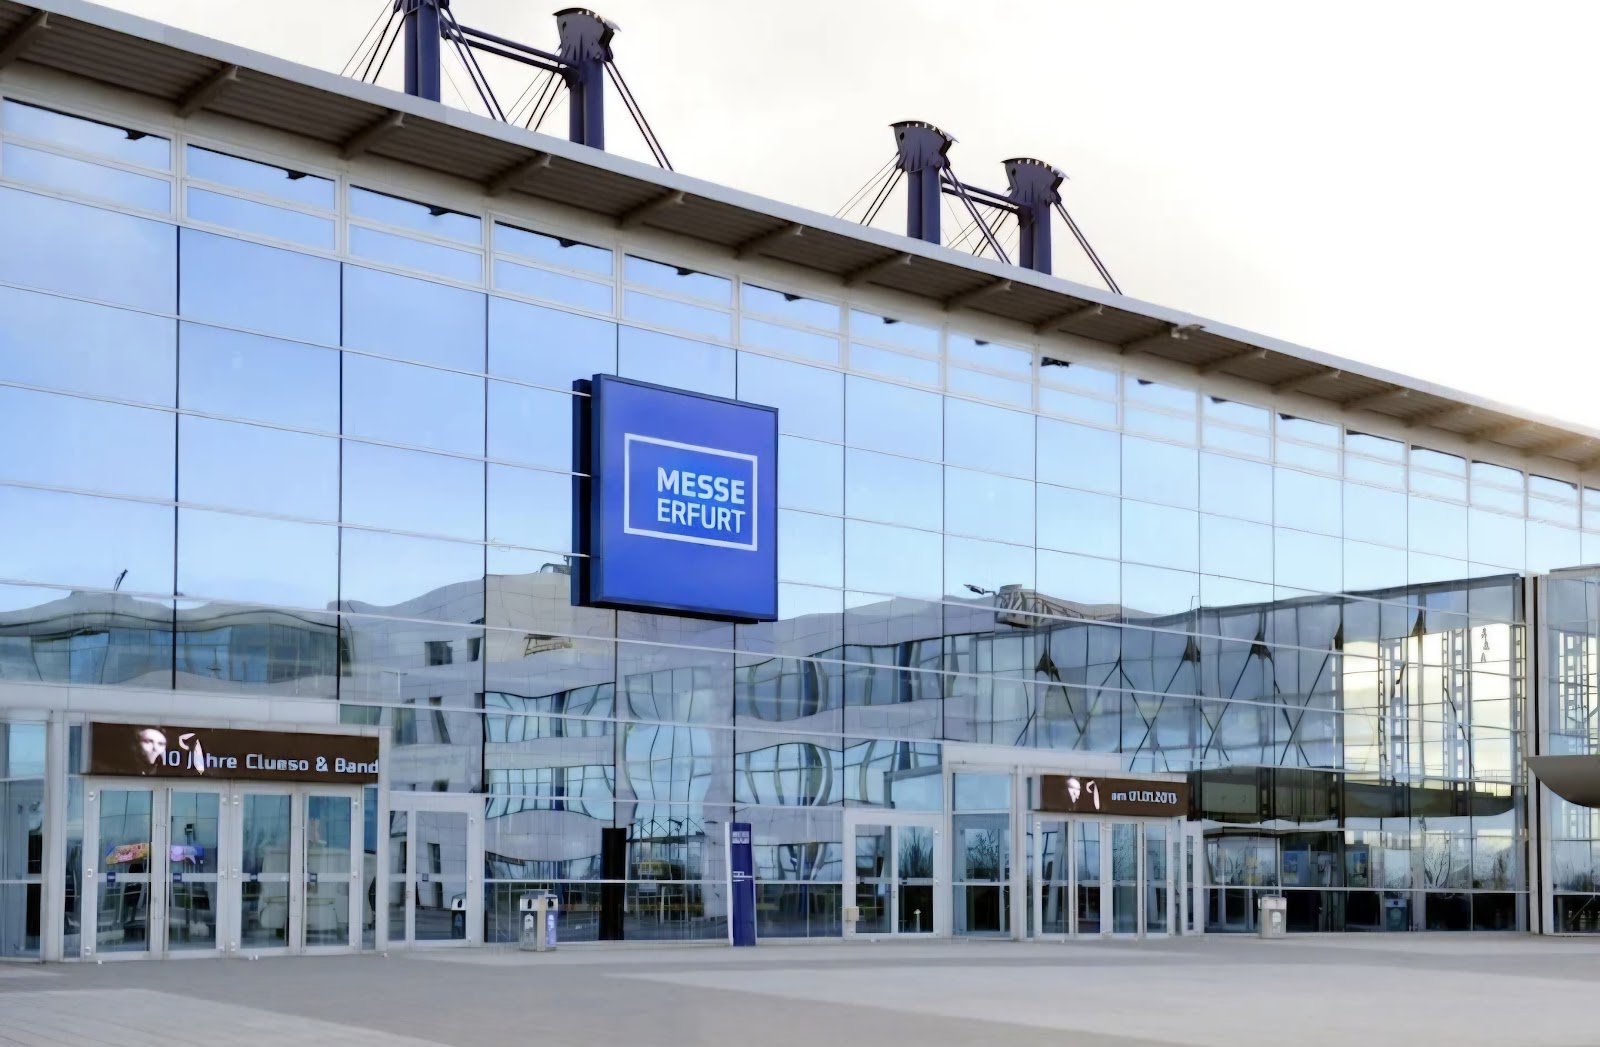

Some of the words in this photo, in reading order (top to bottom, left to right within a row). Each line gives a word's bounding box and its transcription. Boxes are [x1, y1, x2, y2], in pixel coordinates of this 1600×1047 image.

[657, 466, 745, 505] MESSE
[657, 498, 746, 534] ERFURT
[161, 750, 180, 767] 10
[186, 752, 238, 769] Jhre
[315, 756, 329, 772] &
[335, 757, 379, 774] Band
